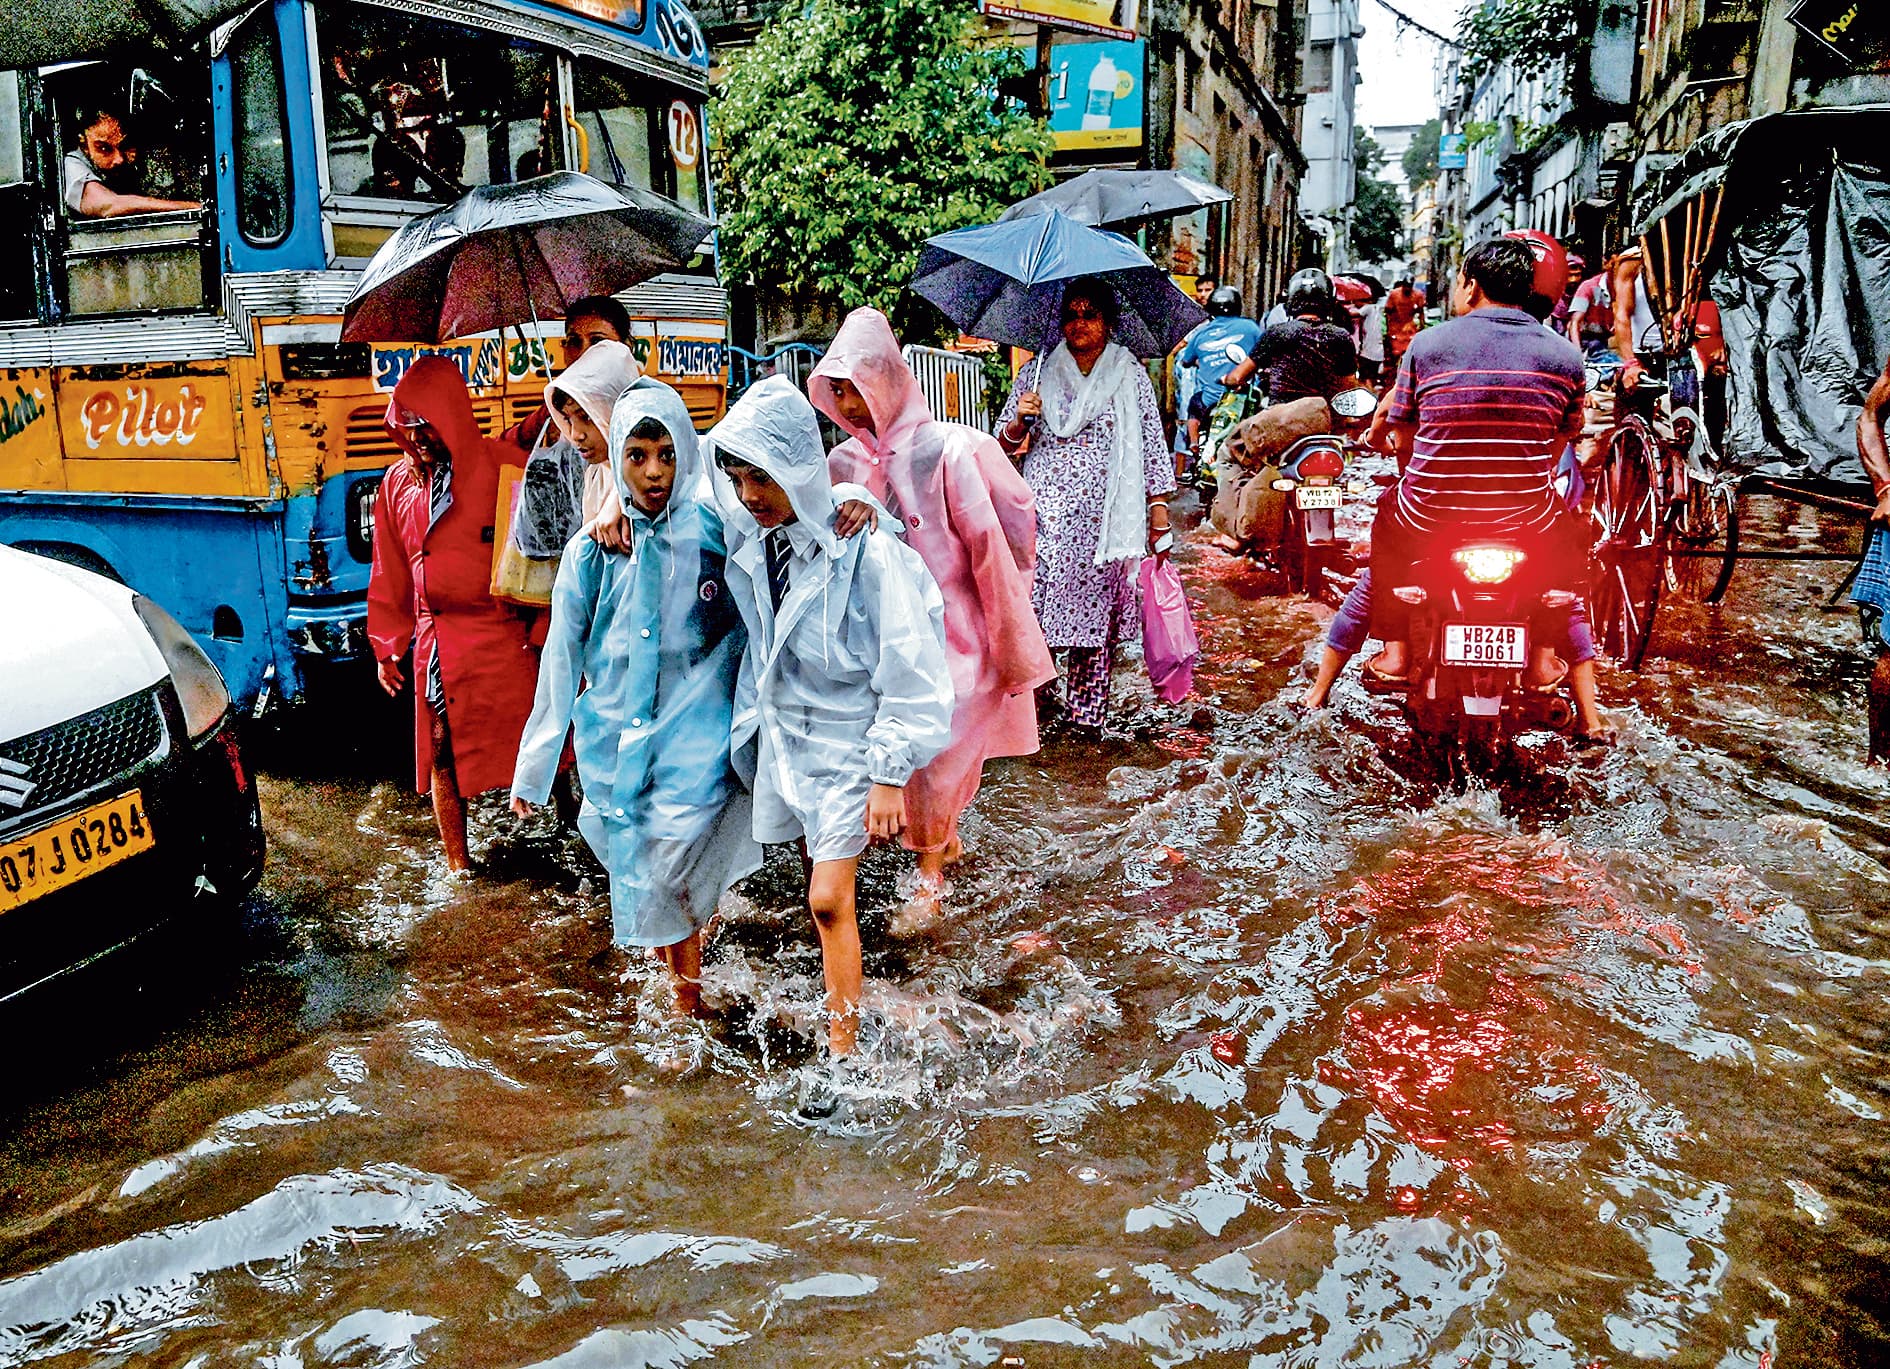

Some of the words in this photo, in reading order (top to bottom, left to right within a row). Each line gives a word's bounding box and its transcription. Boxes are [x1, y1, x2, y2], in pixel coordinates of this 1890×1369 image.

[81, 382, 207, 450] Pilot
[1463, 627, 1516, 644] WB24B
[1463, 644, 1514, 660] P9061
